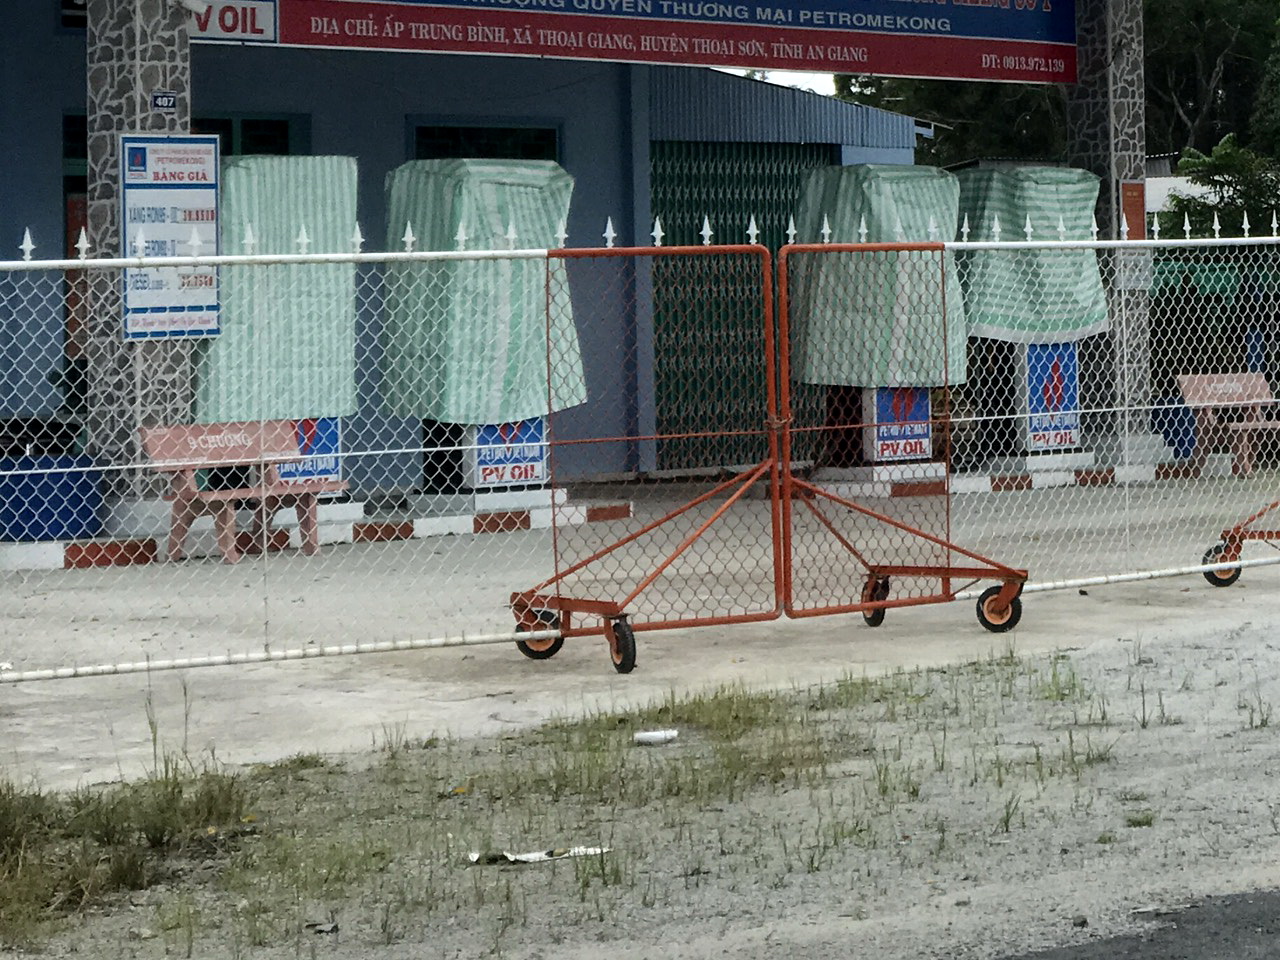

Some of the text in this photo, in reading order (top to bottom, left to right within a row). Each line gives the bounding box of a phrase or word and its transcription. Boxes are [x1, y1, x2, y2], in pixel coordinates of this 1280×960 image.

[194, 5, 264, 34] V OIL
[659, 0, 749, 19] THƯƠNG
[756, 7, 792, 24] MẠI
[799, 10, 951, 31] PETROMEKONG
[310, 13, 869, 63] ĐỊA CHỈ: ẤP TRUNG BÌNH, XÃ THOẠI GIANG, HUYỆN THOẠI SƠN, TỈNH AN GIANG
[982, 53, 1065, 73] ĐT: 0913.972.139
[155, 96, 174, 107] 407
[880, 440, 927, 456] PV OIL
[482, 464, 540, 481] PV OIL
